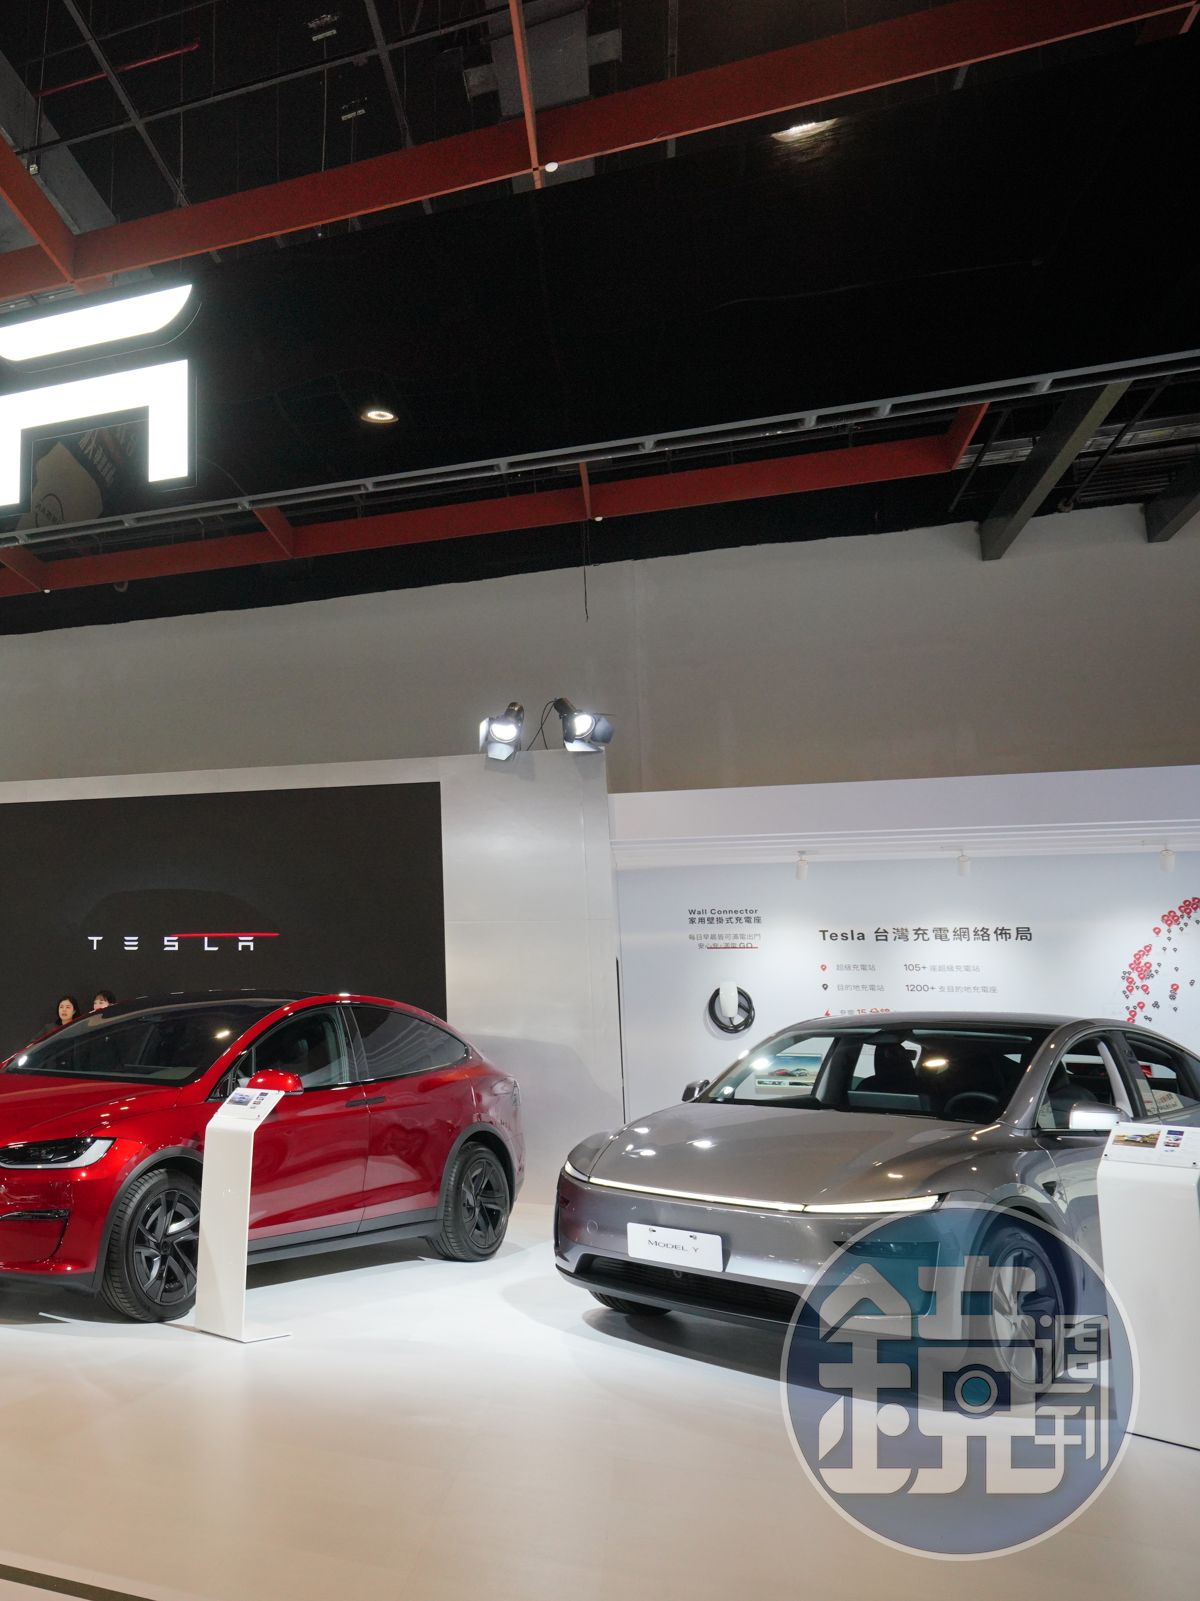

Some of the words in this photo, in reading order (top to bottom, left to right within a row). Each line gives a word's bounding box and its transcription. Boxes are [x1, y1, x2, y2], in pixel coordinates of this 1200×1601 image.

[688, 916, 762, 925] 家用壁掛式充電座
[818, 929, 866, 942] Tesla
[873, 926, 1033, 942] 台灣充電網絡佈局
[87, 936, 254, 951] TESLA
[836, 964, 876, 972] 超級充電站
[903, 963, 927, 972] 105+
[837, 984, 885, 992] 目的地充電站
[905, 984, 936, 992] 1200+
[647, 1239, 688, 1252] MODEL
